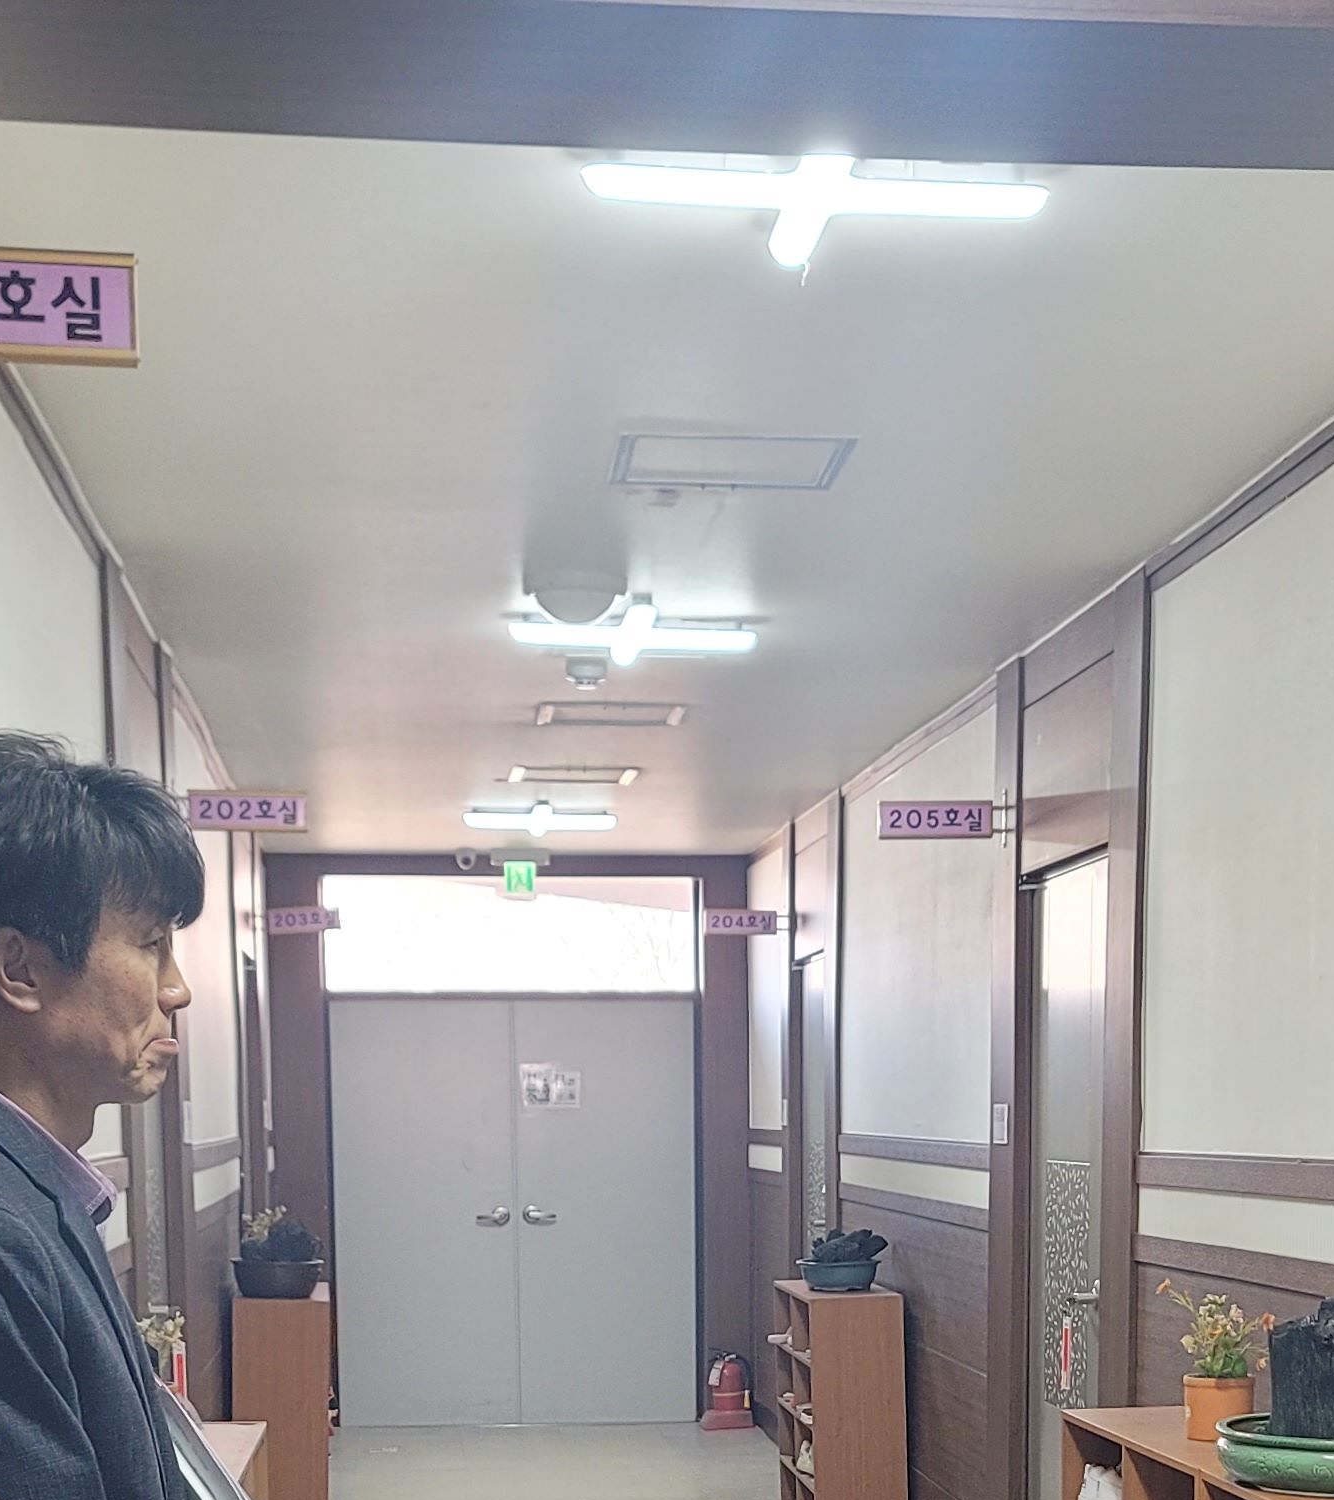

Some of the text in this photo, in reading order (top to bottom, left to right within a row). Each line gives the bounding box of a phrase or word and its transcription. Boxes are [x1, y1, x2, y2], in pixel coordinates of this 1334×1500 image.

[199, 799, 298, 824] 202호실
[889, 808, 983, 832] 205호실
[711, 913, 771, 930] 204호실
